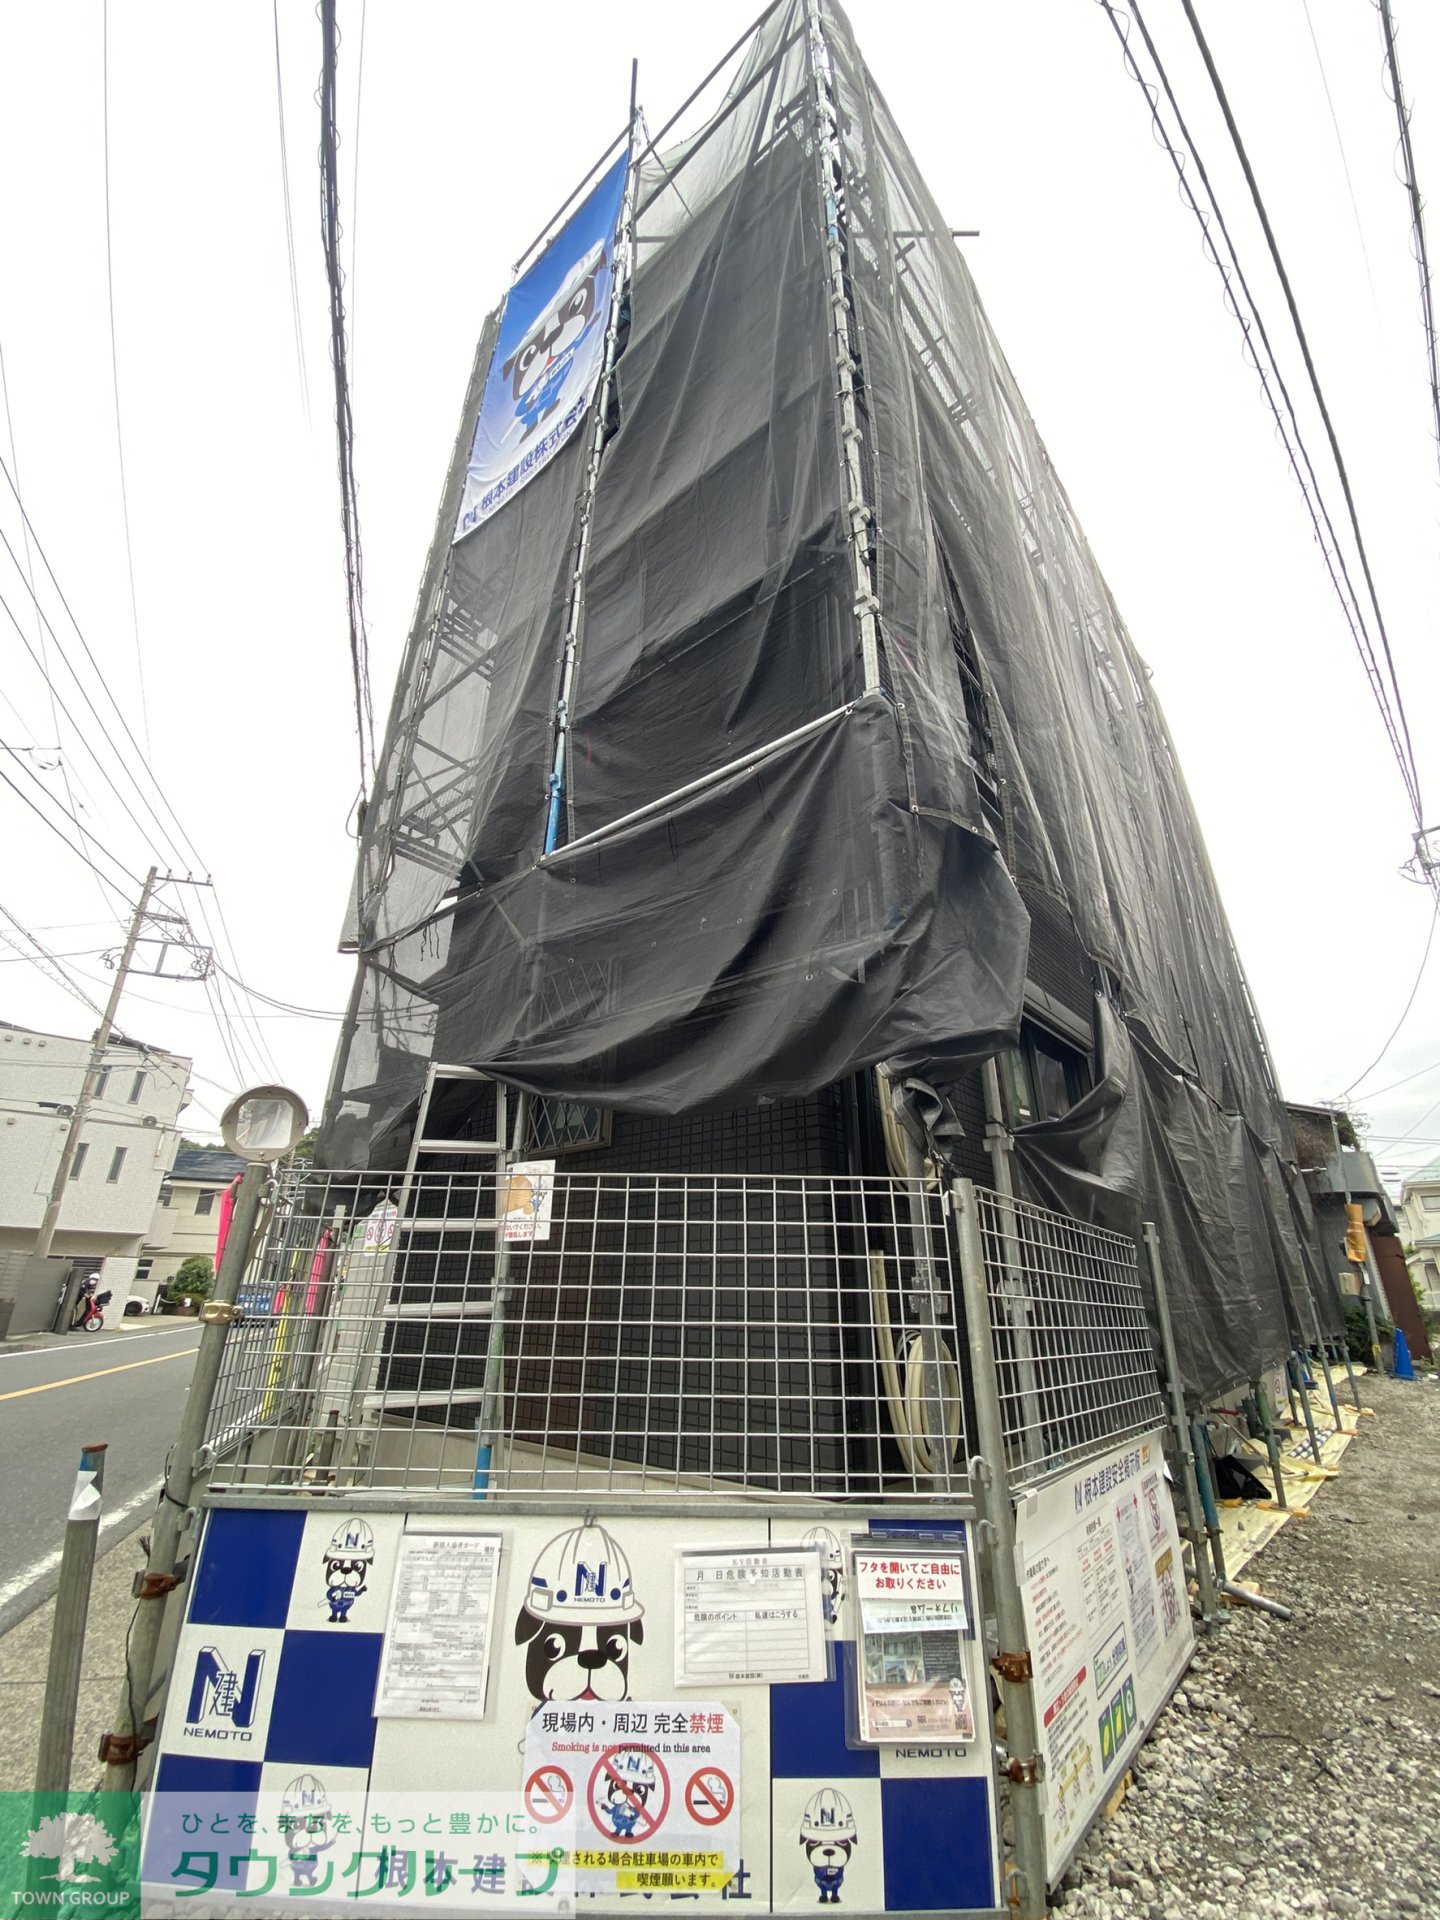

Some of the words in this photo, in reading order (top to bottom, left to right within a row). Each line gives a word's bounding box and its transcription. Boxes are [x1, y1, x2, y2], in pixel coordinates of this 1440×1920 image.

[859, 1561, 960, 1576] フタを開いてご自由に
[875, 1577, 946, 1590] お取りください
[694, 1613, 738, 1622] 危険のポイント
[653, 1712, 725, 1734] 完全禁煙
[183, 1727, 253, 1742] NEMOTO
[551, 1742, 590, 1754] Smoking
[592, 1743, 602, 1753] is
[619, 1743, 660, 1755] permitted
[663, 1743, 672, 1753] in
[673, 1743, 690, 1753] this
[692, 1745, 711, 1753] area
[896, 1748, 967, 1759] NEMOTO
[637, 1871, 717, 1888] 喫煙願います。
